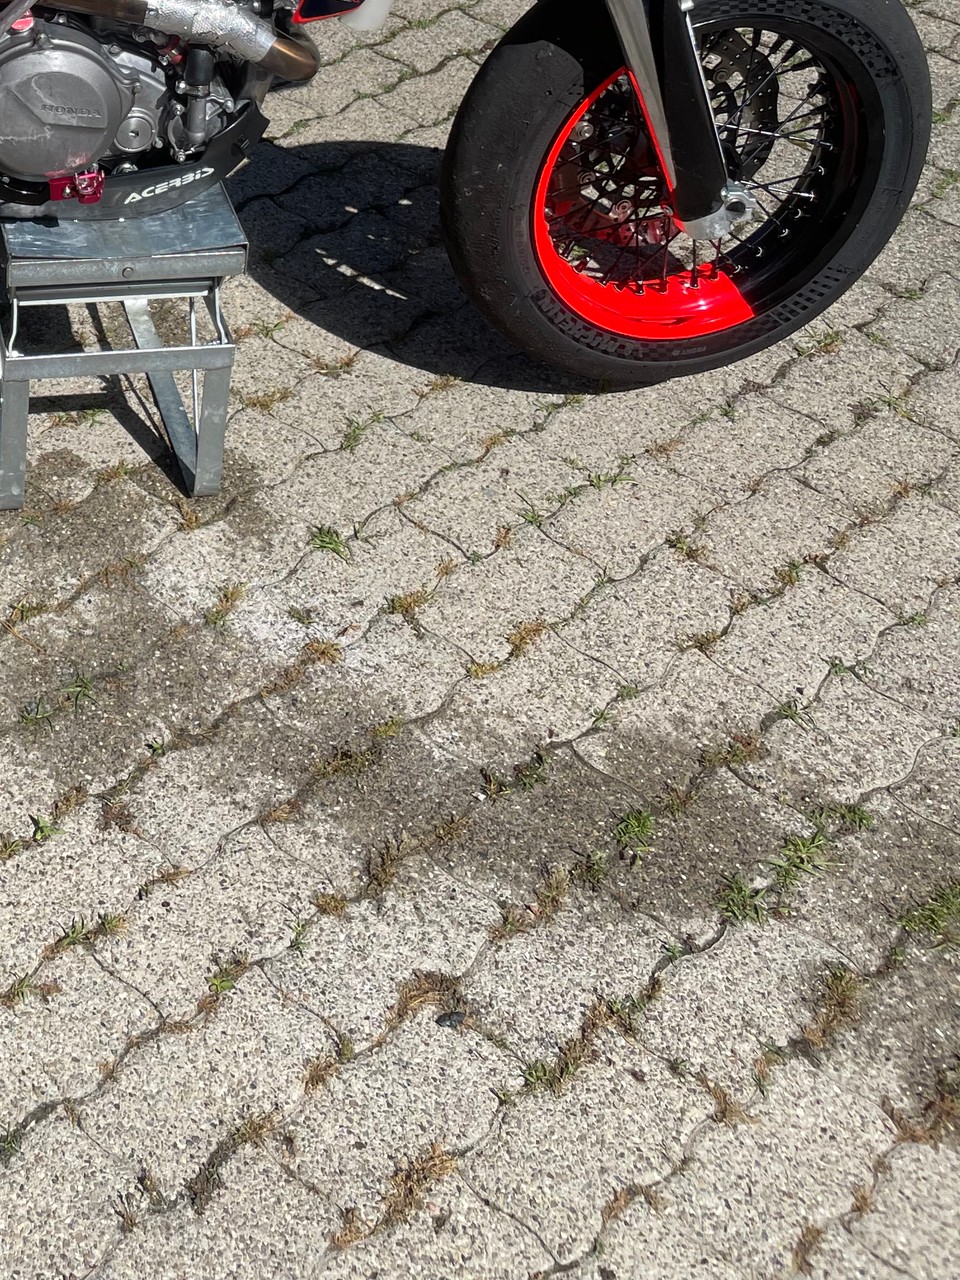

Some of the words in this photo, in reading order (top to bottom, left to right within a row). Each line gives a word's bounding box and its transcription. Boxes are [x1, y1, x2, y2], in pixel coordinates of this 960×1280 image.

[41, 104, 102, 118] HONDA
[124, 167, 215, 205] ACERBIS
[536, 290, 618, 353] MICHELIN
